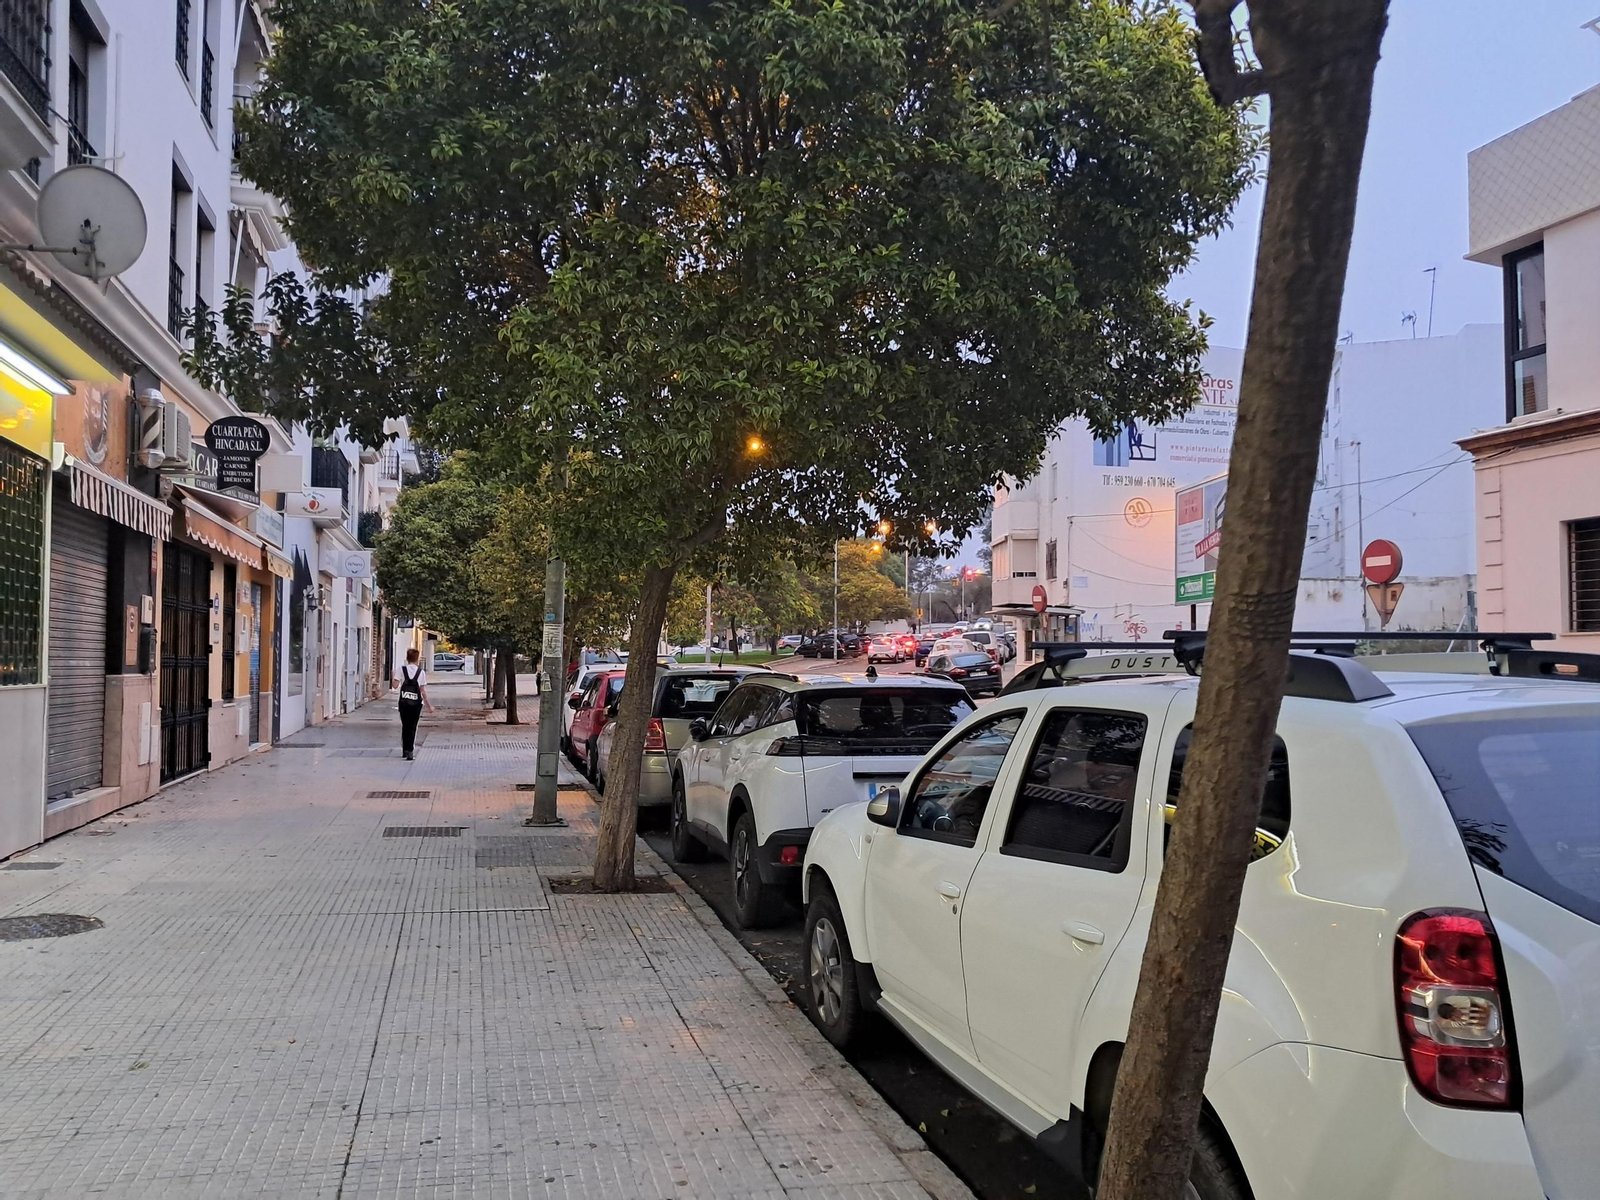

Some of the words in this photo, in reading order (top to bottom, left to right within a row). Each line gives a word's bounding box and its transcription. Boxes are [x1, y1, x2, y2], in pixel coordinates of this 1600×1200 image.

[212, 425, 242, 438] CUARTA
[243, 424, 263, 438] PEÑA
[215, 438, 250, 451] HINCADA
[250, 440, 263, 452] S.L.
[1114, 475, 1124, 487] 959
[1124, 476, 1134, 487] 230
[1134, 476, 1144, 487] 660
[1147, 476, 1156, 488] 670
[1157, 476, 1166, 488] 704
[1166, 477, 1176, 488] 645
